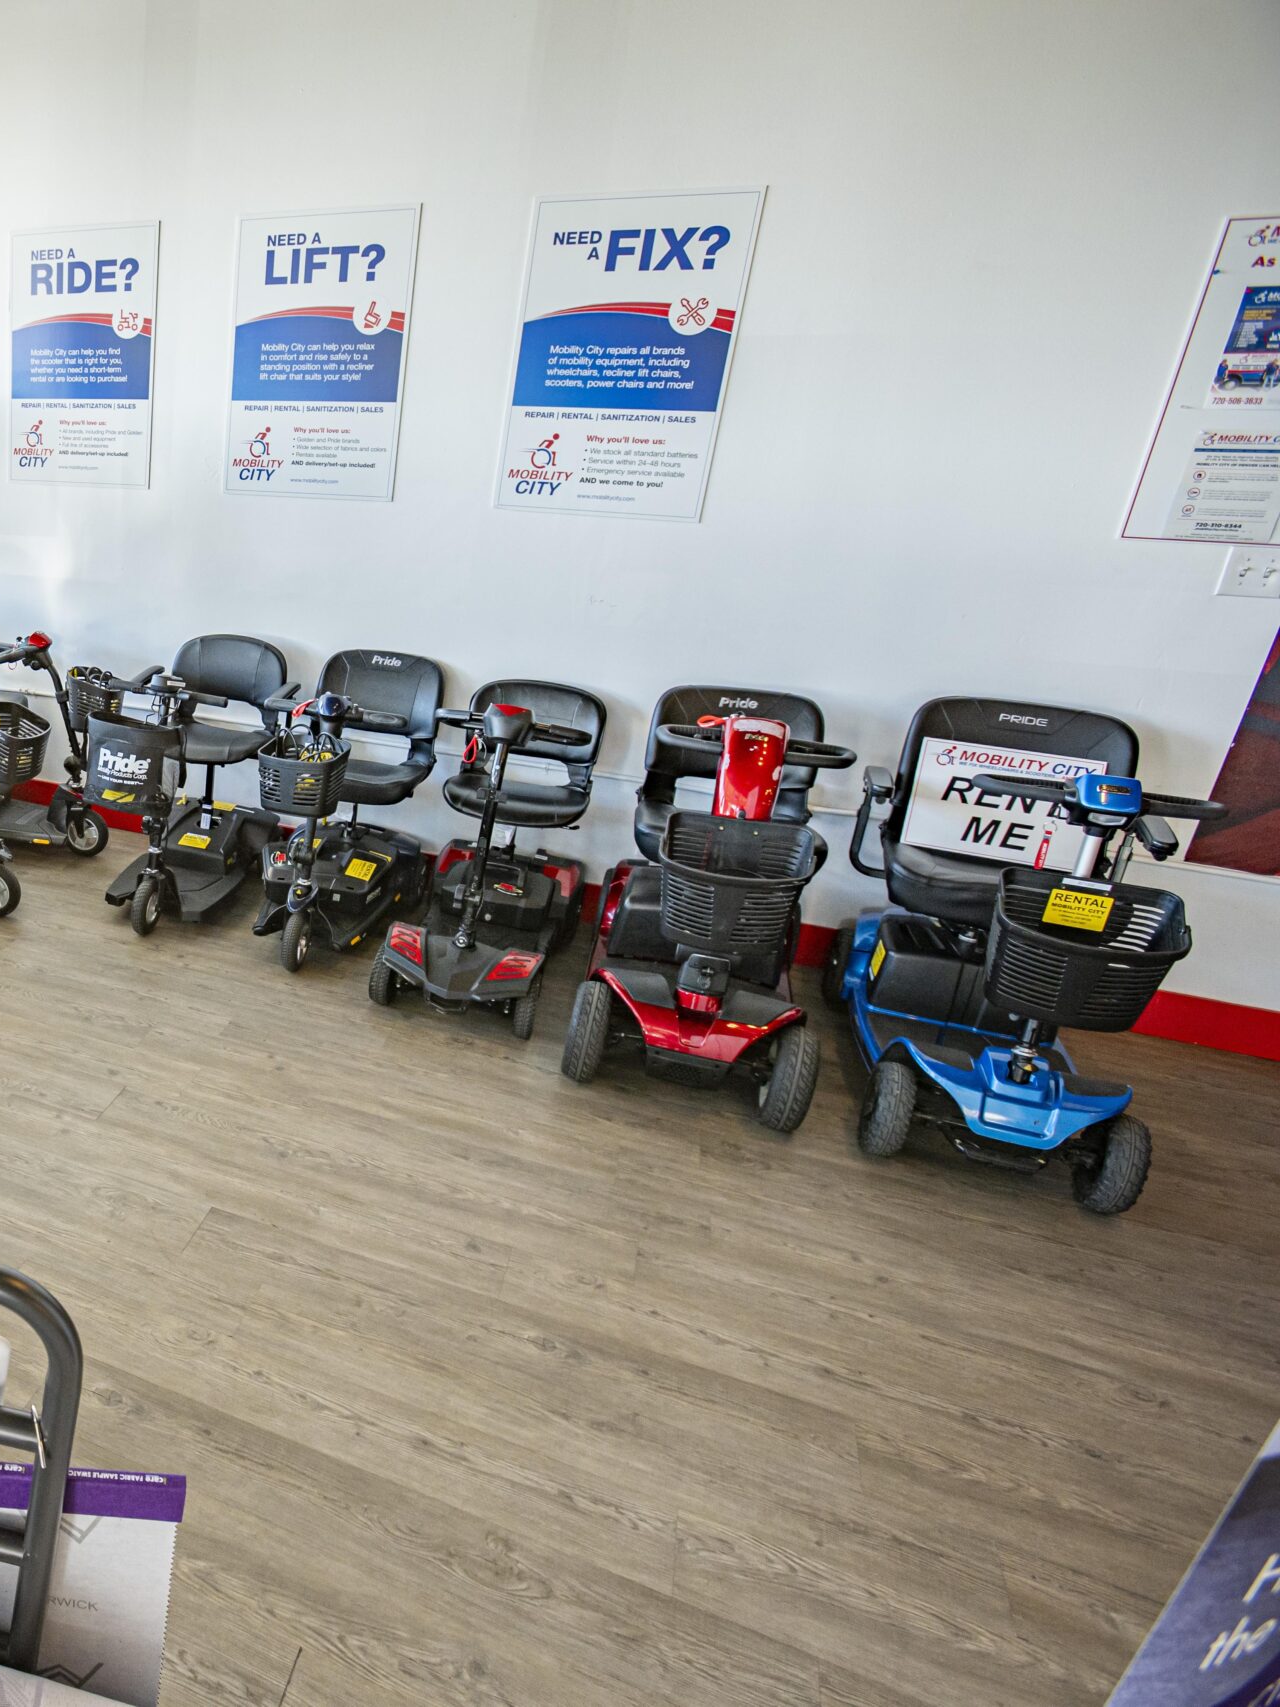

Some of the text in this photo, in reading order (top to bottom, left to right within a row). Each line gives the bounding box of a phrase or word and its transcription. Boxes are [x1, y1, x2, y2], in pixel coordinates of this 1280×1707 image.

[267, 232, 321, 247] NEED A
[553, 231, 602, 246] NEED
[31, 248, 75, 261] NEED A
[587, 247, 600, 260] A
[604, 225, 731, 272] FIX?
[265, 243, 386, 286] LIFT?
[1251, 256, 1276, 268] As
[30, 257, 140, 296] RIDE?
[261, 343, 289, 352] Mobility
[291, 343, 306, 352] City
[322, 343, 339, 352] help
[340, 344, 354, 352] you
[356, 342, 375, 351] relax
[550, 345, 686, 356] Mobility City repairs all brands
[261, 353, 267, 361] in
[269, 353, 297, 361] comfort
[330, 353, 351, 362] safely
[548, 356, 690, 368] of mobility equipment, including
[260, 363, 290, 372] standing
[292, 363, 321, 371] position
[547, 368, 682, 379] wheelchairs, recliner lift chairs,
[323, 374, 340, 382] your
[341, 372, 362, 382] style!
[544, 379, 694, 390] scooters, power chairs and more!
[306, 405, 355, 413] SANITIZATION
[524, 411, 697, 424] REPAIR RENTAL SANITIZATION SALES
[586, 435, 605, 444] Why
[607, 436, 630, 445] you'll
[632, 436, 650, 445] love
[1218, 434, 1272, 443] MOBILITY
[13, 448, 54, 456] MOBILITY
[601, 448, 622, 456] stock
[634, 449, 665, 458] standard
[667, 451, 699, 459] batteries
[19, 456, 48, 468] CITY
[232, 458, 284, 468] MOBILITY
[588, 457, 681, 468] Service within 24-48 hours
[239, 468, 276, 482] CITY
[508, 469, 573, 482] MOBILITY
[586, 467, 625, 476] Emergency
[654, 470, 685, 478] available
[515, 480, 562, 496] CITY
[372, 655, 402, 667] Pride
[719, 697, 758, 709] Pride
[999, 713, 1048, 727] PRIDE
[98, 747, 149, 774] Pride
[960, 750, 1097, 778] MOBILITY CITY
[960, 816, 1035, 851] ME
[1054, 892, 1107, 909] RENTAL
[1051, 903, 1086, 912] MOBILITY
[4, 1464, 25, 1474] icare
[68, 1470, 167, 1486] icare FABRIC SAMPLE SWATC
[1199, 1615, 1279, 1671] the
